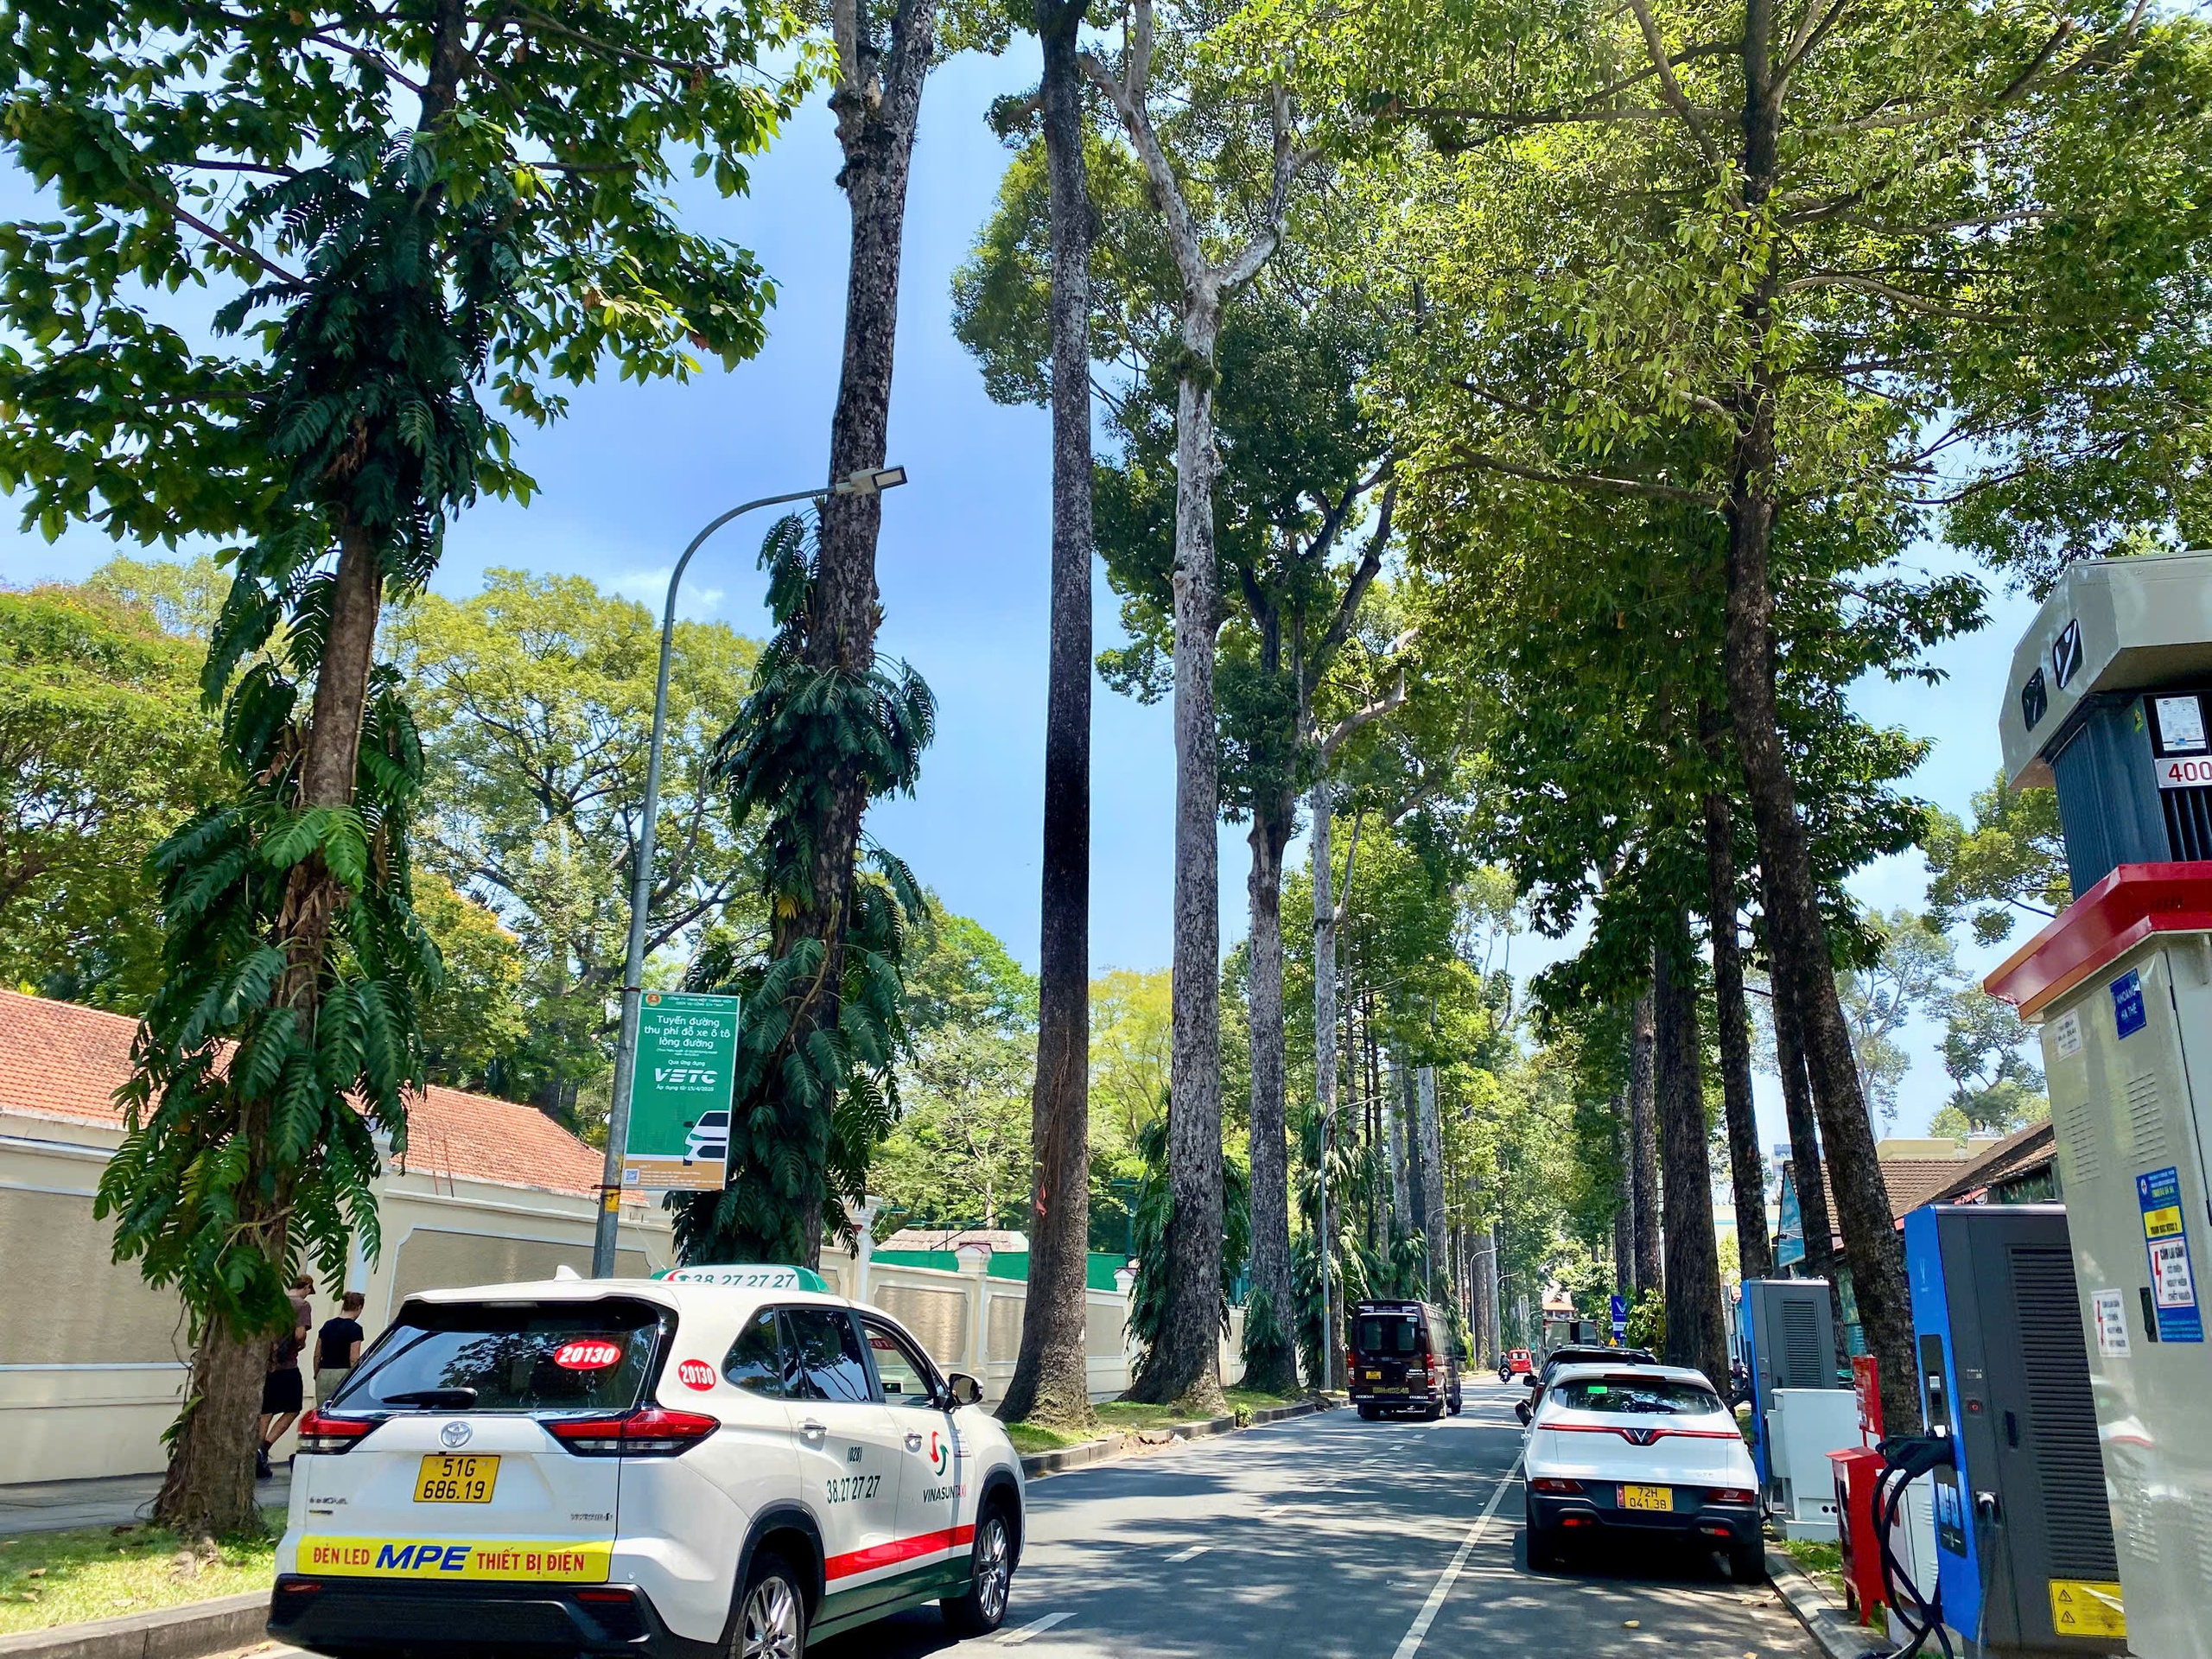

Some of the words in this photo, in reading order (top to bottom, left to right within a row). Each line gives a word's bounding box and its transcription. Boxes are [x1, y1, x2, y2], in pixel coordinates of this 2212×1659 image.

[2168, 761, 2212, 782] 400
[657, 1015, 687, 1026] Tuyến
[689, 1017, 720, 1028] đường
[644, 1026, 660, 1034] thu
[664, 1026, 679, 1036] phí
[681, 1026, 694, 1036] đỗ
[711, 1028, 718, 1037] ô
[720, 1029, 731, 1038] tô
[658, 1037, 680, 1047] lòng
[683, 1039, 714, 1049] đường
[655, 1068, 718, 1084] VETC
[721, 1274, 743, 1286] 27
[747, 1274, 770, 1287] 27
[772, 1274, 795, 1288] 27
[558, 1346, 616, 1363] 20130
[680, 1365, 714, 1385] 20130
[847, 1446, 862, 1464] (028)
[442, 1459, 476, 1477] 51G
[423, 1480, 486, 1499] 686.19
[851, 1476, 865, 1501] 27
[865, 1475, 880, 1499] 27
[1637, 1487, 1658, 1497] 72H
[344, 1548, 370, 1565] LED
[375, 1544, 473, 1571] MPE
[477, 1547, 520, 1571] THIẾT
[525, 1553, 542, 1574] BỊ
[547, 1549, 585, 1574] ĐIỆN
